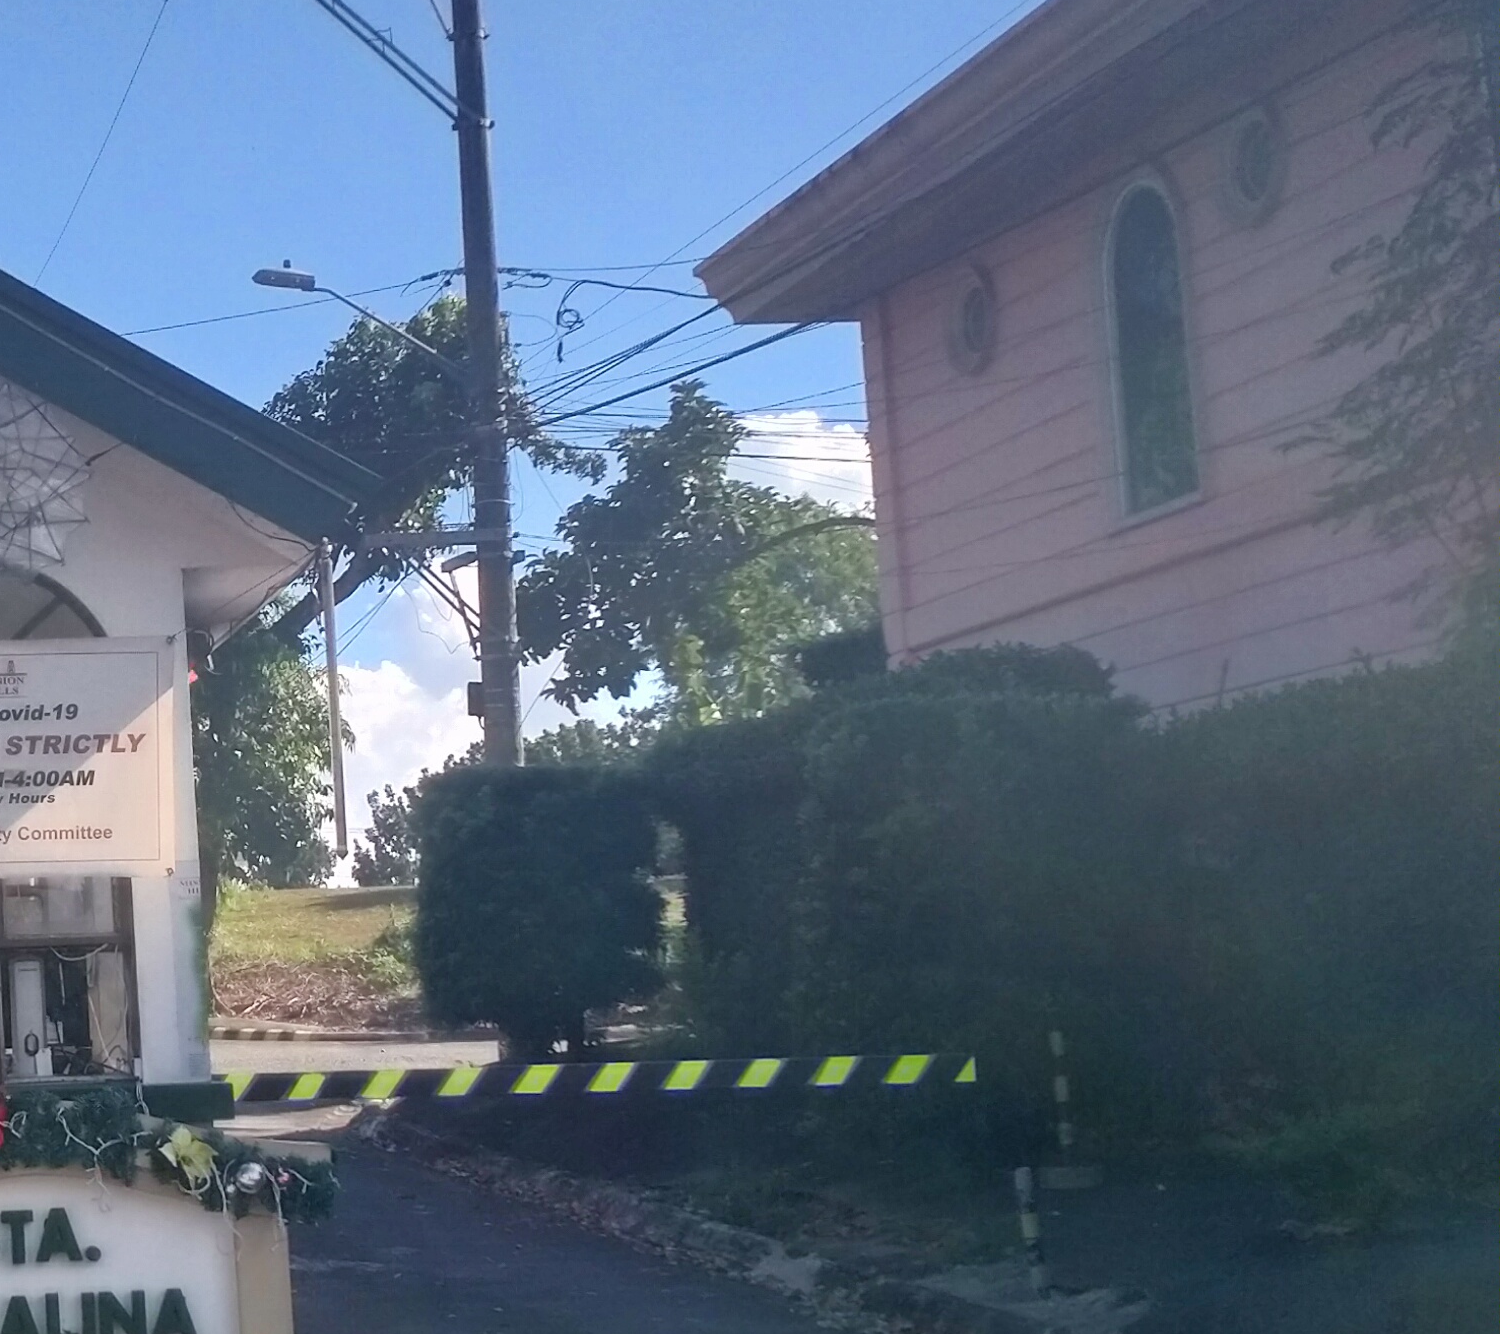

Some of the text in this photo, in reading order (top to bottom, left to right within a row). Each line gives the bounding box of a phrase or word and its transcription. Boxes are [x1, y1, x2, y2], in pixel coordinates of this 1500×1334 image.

[5, 733, 146, 756] STRICTLY
[8, 792, 55, 804] Hours
[18, 825, 113, 841] Committee
